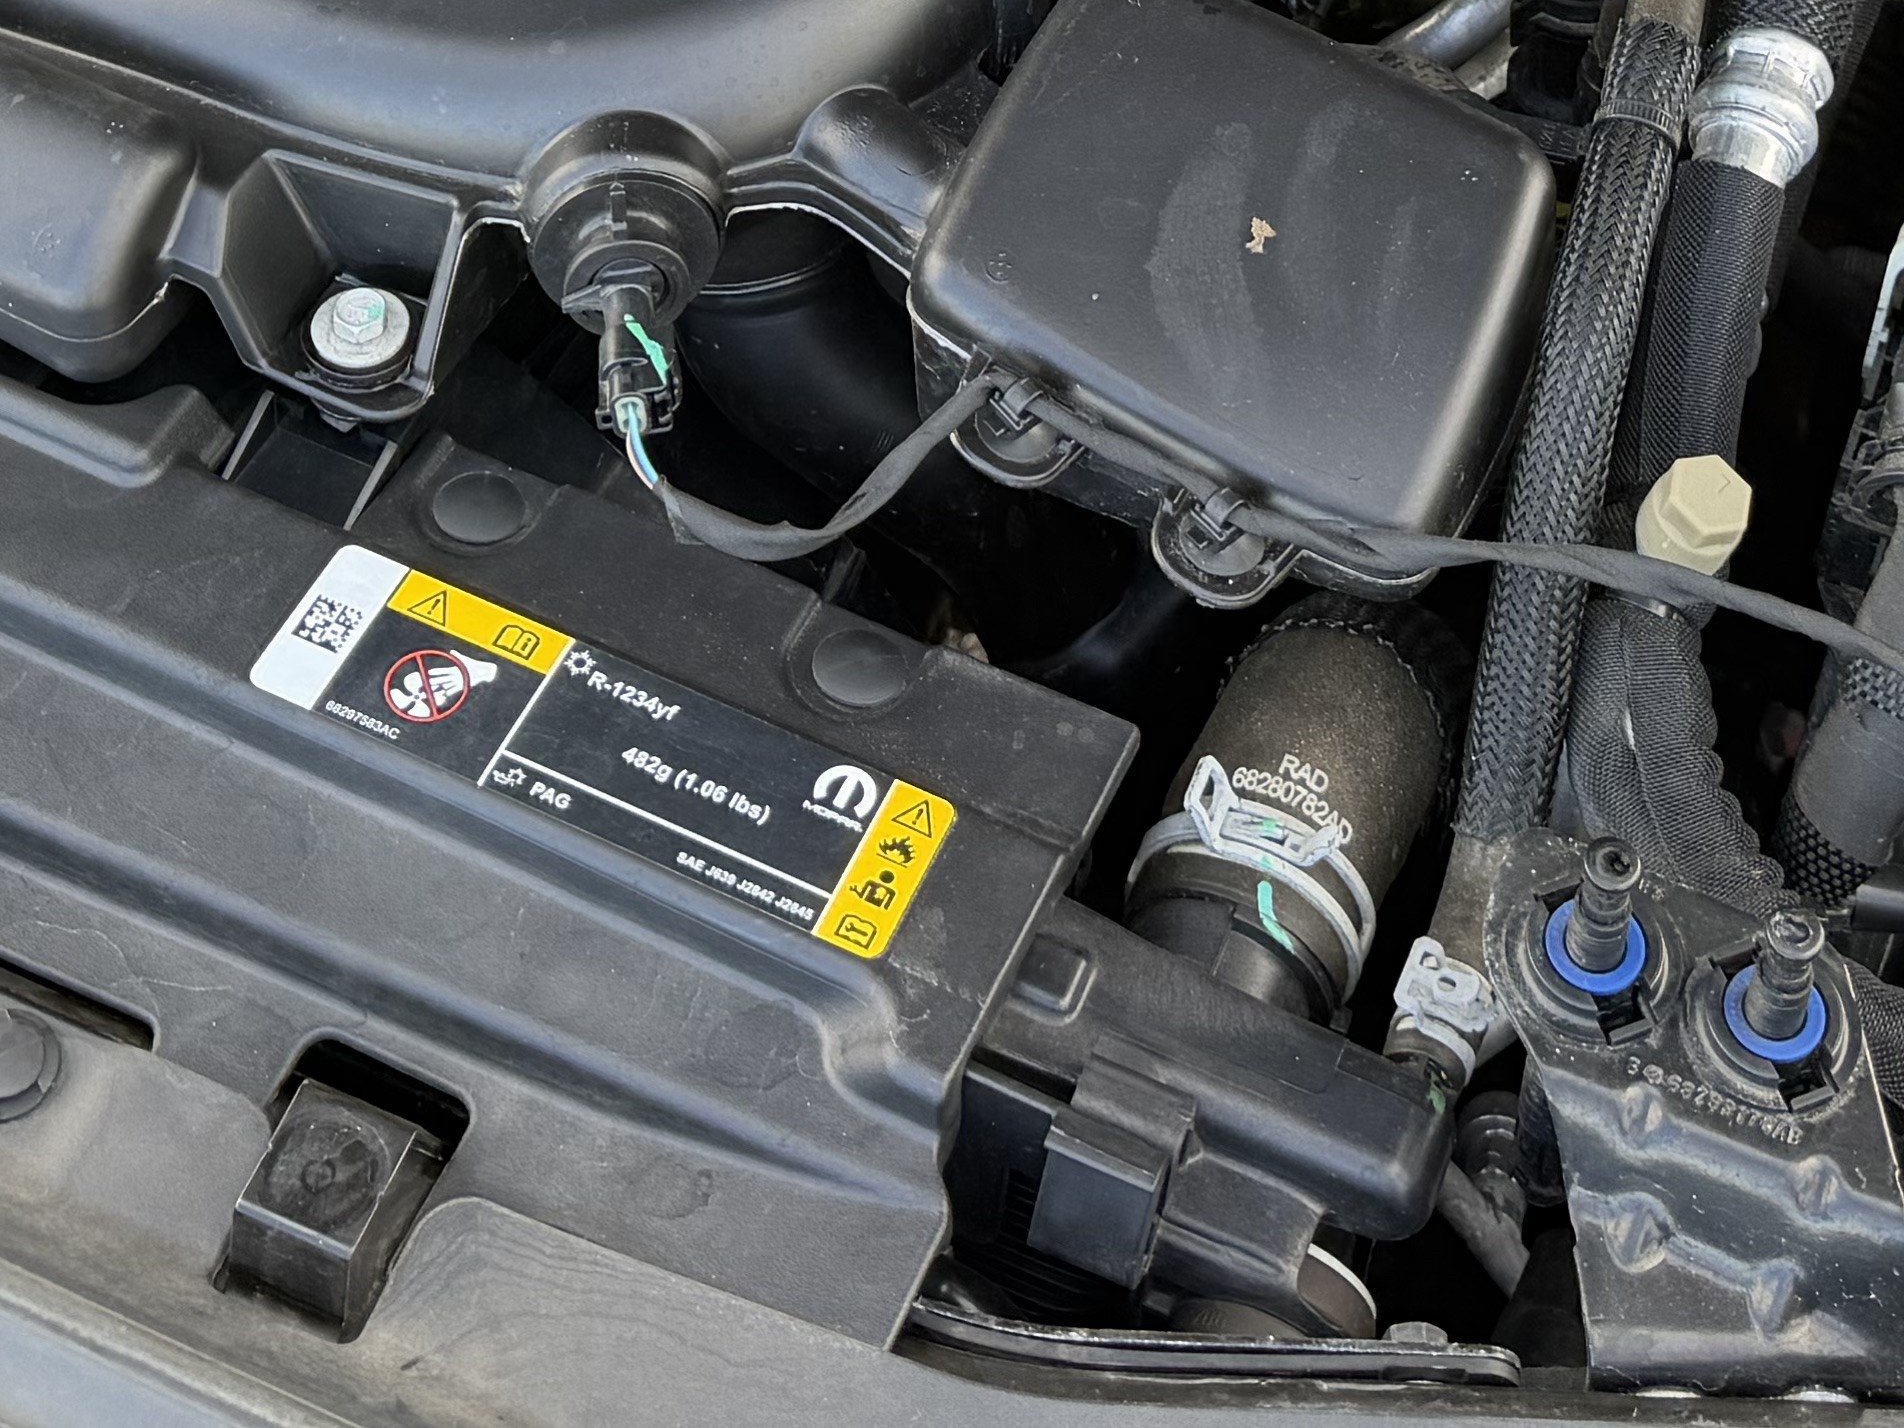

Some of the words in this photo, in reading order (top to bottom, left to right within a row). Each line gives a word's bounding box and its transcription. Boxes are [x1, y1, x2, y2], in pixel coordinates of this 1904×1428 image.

[586, 669, 683, 723] R-1234yf
[528, 780, 572, 811] PAG
[620, 745, 674, 784] 482g
[674, 766, 729, 806] (1.06
[729, 791, 771, 826] lbs)
[1278, 753, 1330, 794] RAD
[1232, 766, 1353, 844] 68280782AD
[677, 851, 706, 873] SAE
